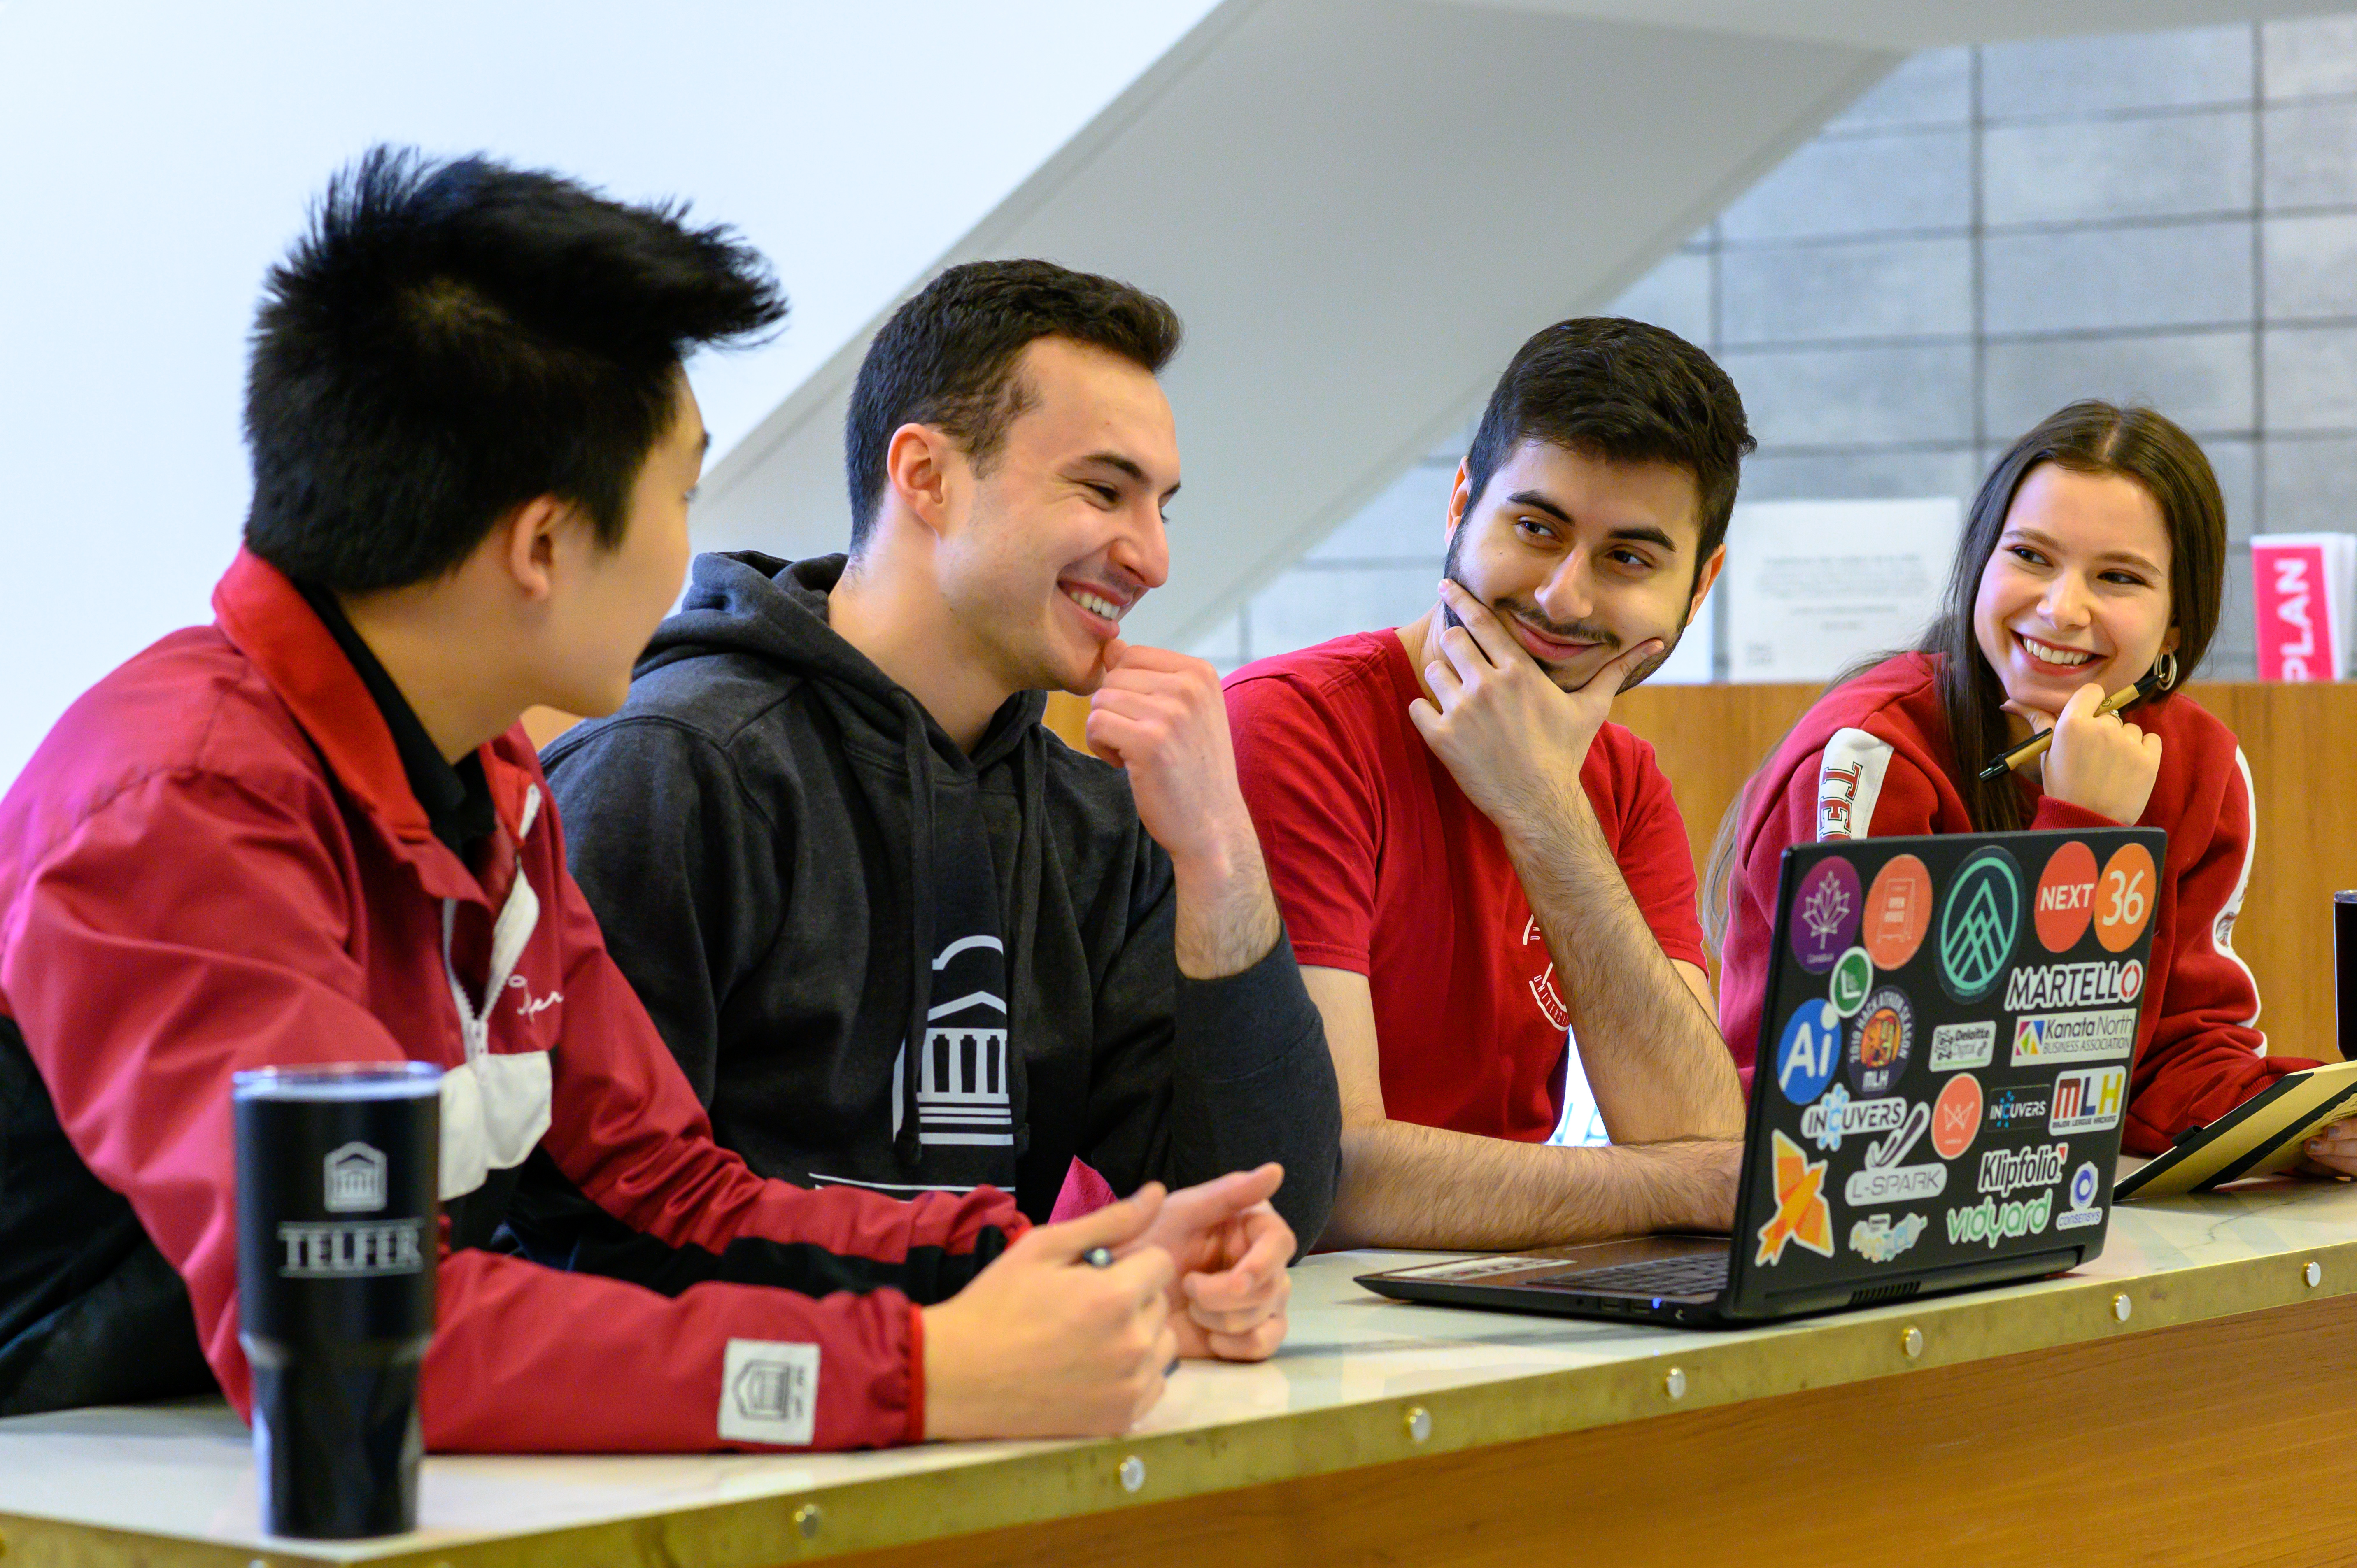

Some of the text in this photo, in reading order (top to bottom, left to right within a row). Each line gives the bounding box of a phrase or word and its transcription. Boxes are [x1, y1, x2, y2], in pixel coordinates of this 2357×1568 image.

[2274, 558, 2315, 682] PLAN
[1818, 761, 1863, 840] TE
[2040, 869, 2144, 926] NEXT 36
[2008, 965, 2140, 1004] MARTELLO
[1779, 1002, 1839, 1091] Ai
[2043, 1037, 2129, 1054] BUSINESS ASSOCIATION
[2045, 1014, 2133, 1039] Kanata North
[1808, 1103, 1902, 1134] INCUVERS
[1989, 1100, 2047, 1120] INCUVERS
[2054, 1073, 2123, 1119] MLH
[1853, 1170, 1940, 1198] L-SPARK
[1949, 1192, 2052, 1246] vidyard
[277, 1223, 423, 1274] TELFER
